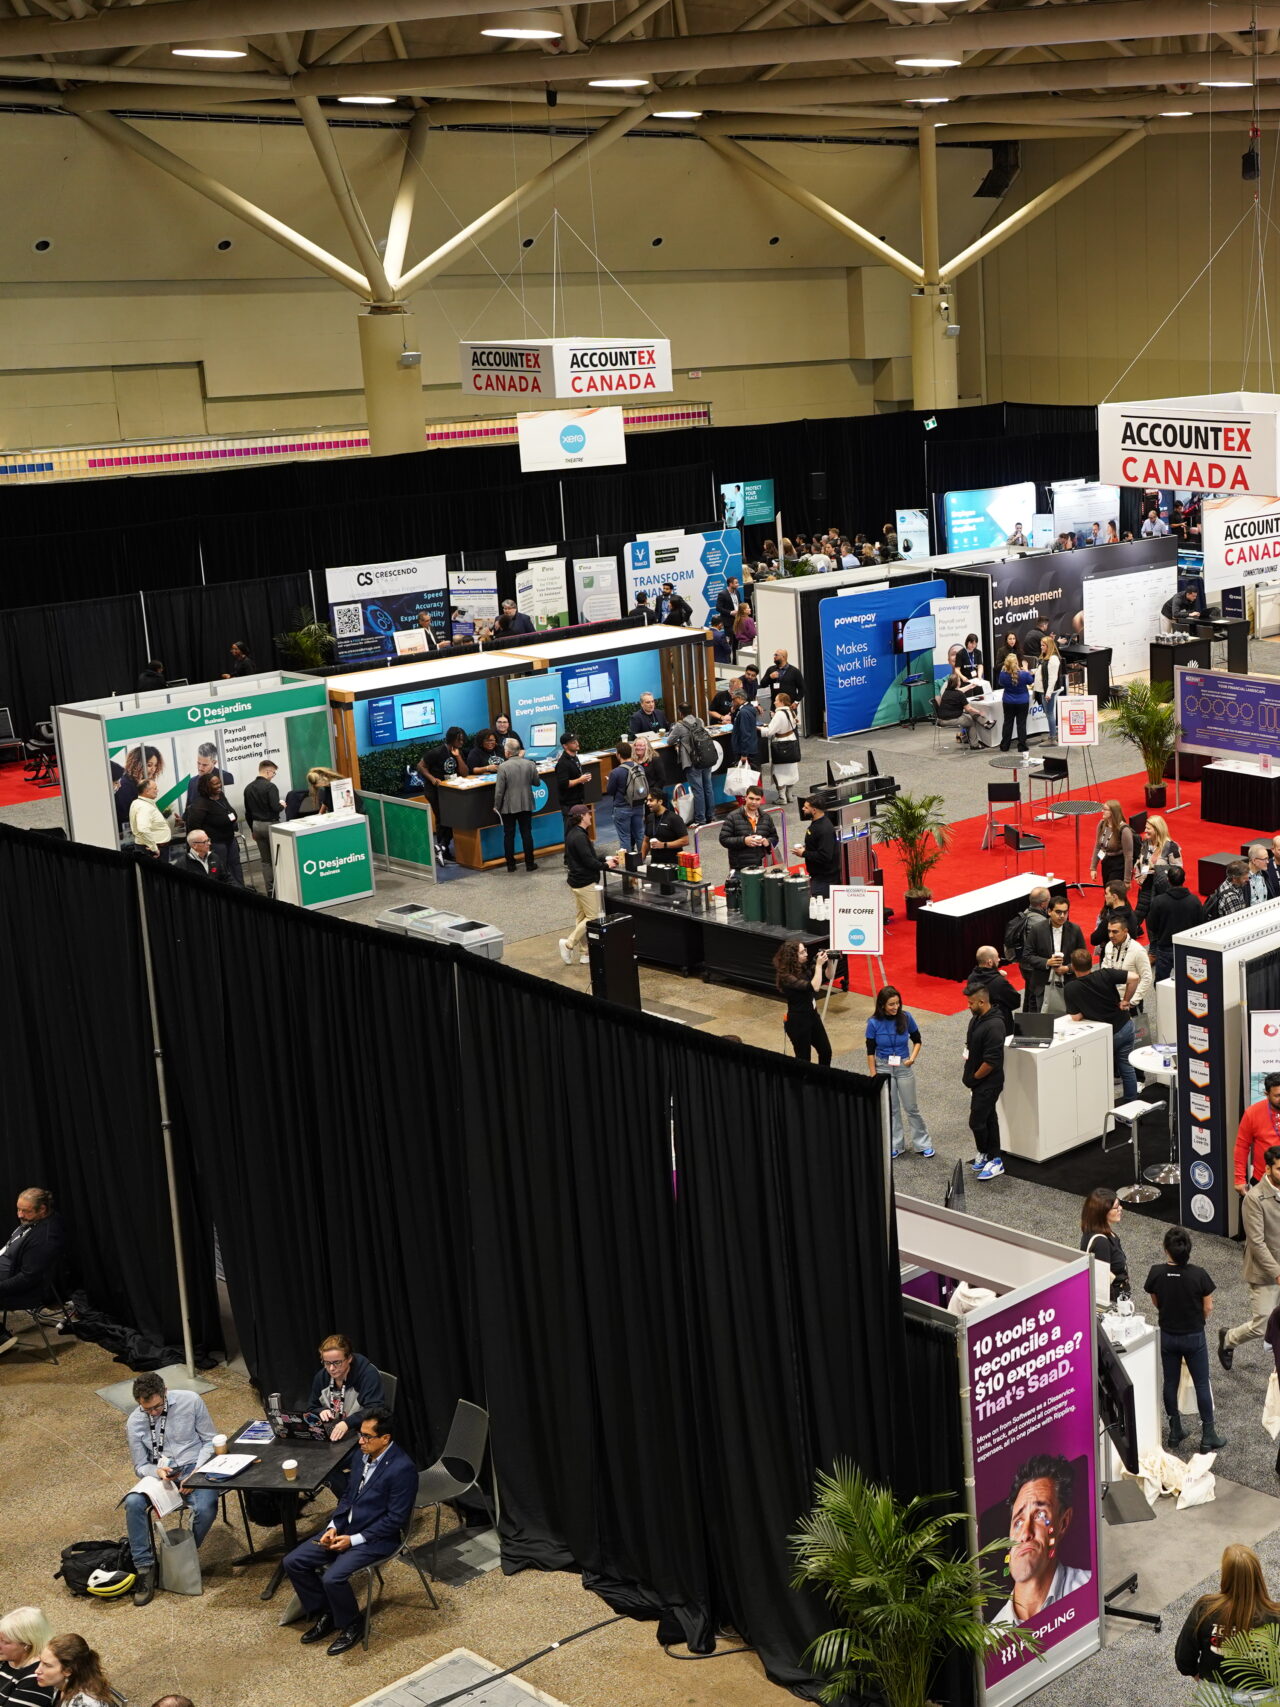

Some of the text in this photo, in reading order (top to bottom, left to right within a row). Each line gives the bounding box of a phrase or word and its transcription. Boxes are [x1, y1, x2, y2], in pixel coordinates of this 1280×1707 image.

[472, 351, 540, 369] ACCOUNTEX
[570, 350, 656, 369] ACCOUNTEX
[473, 374, 541, 392] CANADA
[571, 373, 656, 393] CANADA
[562, 434, 584, 443] xero
[1121, 422, 1251, 452] ACCOUNTEX
[1122, 456, 1250, 491] CANADA
[357, 567, 417, 586] CS CRESCENDO
[633, 569, 695, 587] TRANSFORM
[1243, 565, 1278, 577] CONNECTION LOUNGE
[424, 591, 443, 599] Speed
[1005, 588, 1062, 607] Management
[416, 601, 443, 610] Accuracy
[938, 604, 969, 612] powerpay
[834, 613, 877, 628] powerpay
[994, 607, 1038, 626] or Growth
[836, 642, 868, 656] Makes
[837, 655, 877, 672] work life
[838, 675, 867, 689] better.
[518, 694, 555, 706] One Install.
[204, 701, 252, 718] Desjardins
[515, 704, 560, 716] Every Return.
[205, 717, 226, 725] Business
[224, 725, 246, 736] Payroll
[225, 731, 267, 744] management
[225, 743, 251, 753] solution
[227, 747, 280, 762] accounting firms
[319, 852, 365, 870] Desjardins
[320, 869, 340, 877] Business
[973, 1308, 1055, 1359] 10 tools to
[974, 1325, 1061, 1382] reconcile a
[975, 1331, 1083, 1402] $10 expense?
[975, 1358, 1074, 1422] That's SaaD.
[977, 1432, 991, 1444] Move
[1000, 1420, 1012, 1431] from
[1012, 1408, 1035, 1423] Software
[1048, 1387, 1075, 1405] Disservice.
[977, 1442, 992, 1453] Unite,
[993, 1433, 1007, 1444] track,
[1008, 1425, 1018, 1436] and
[1019, 1416, 1036, 1429] control
[1044, 1400, 1068, 1416] company
[978, 1445, 1003, 1462] expenses,
[1016, 1431, 1026, 1440] one
[1027, 1423, 1041, 1435] place
[1042, 1416, 1053, 1426] with
[1054, 1405, 1076, 1420] Rippling.
[1021, 1608, 1075, 1650] PPLING
